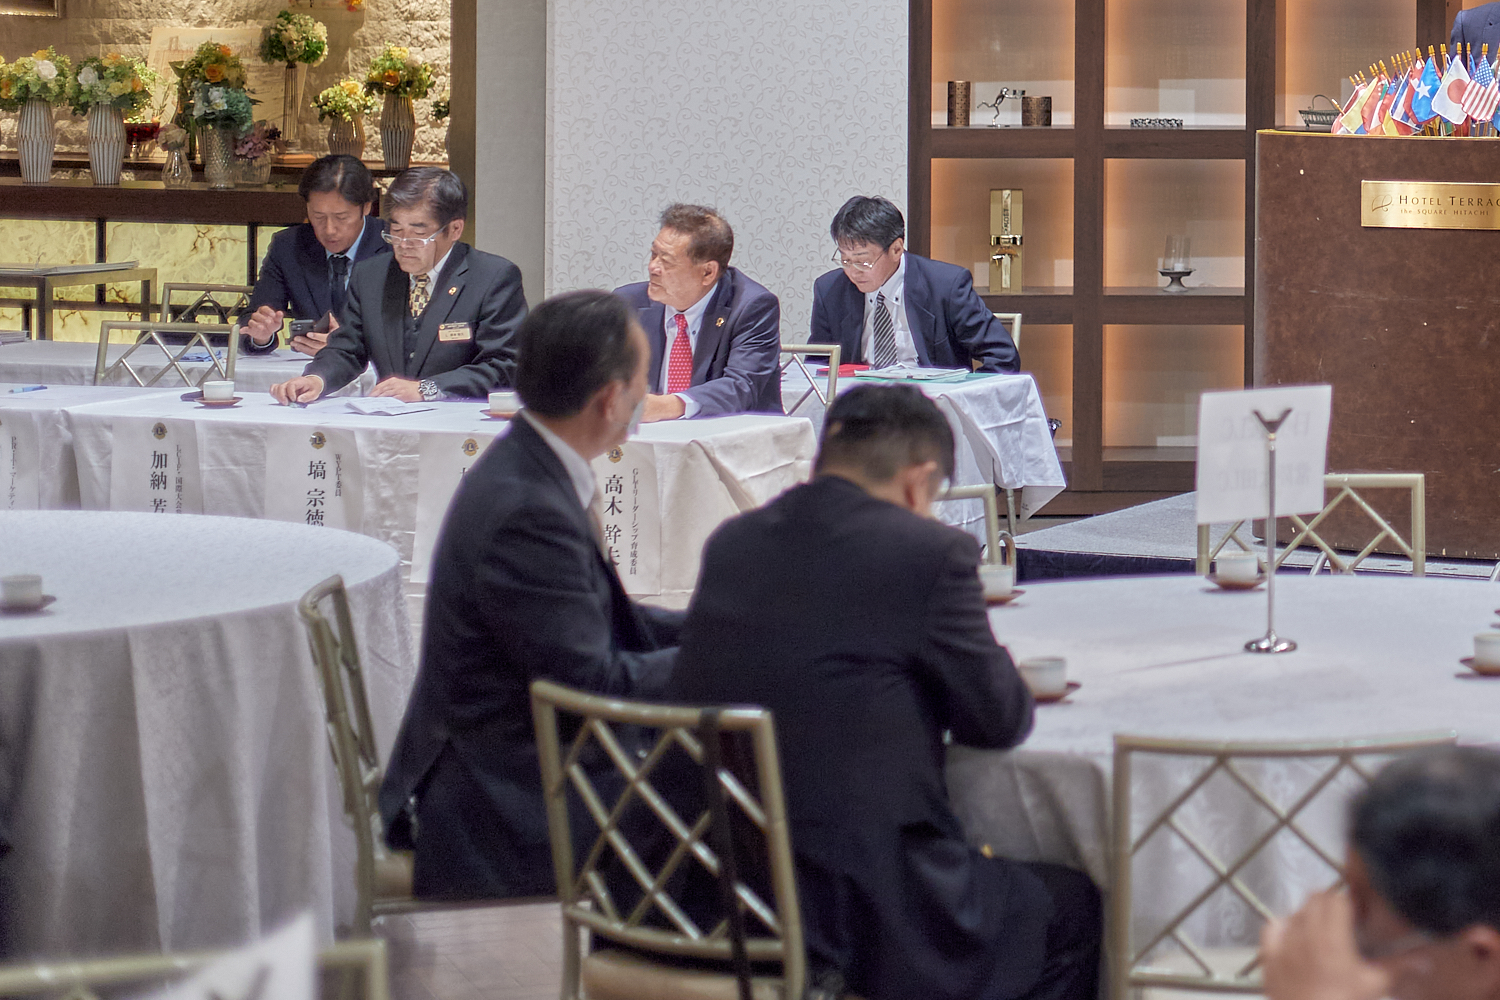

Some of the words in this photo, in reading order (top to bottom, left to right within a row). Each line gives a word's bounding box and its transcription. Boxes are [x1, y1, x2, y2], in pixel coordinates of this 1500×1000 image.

[1399, 195, 1442, 206] HOTEL
[150, 451, 168, 490] 加納
[307, 460, 327, 480] 塙
[604, 474, 623, 516] 高木
